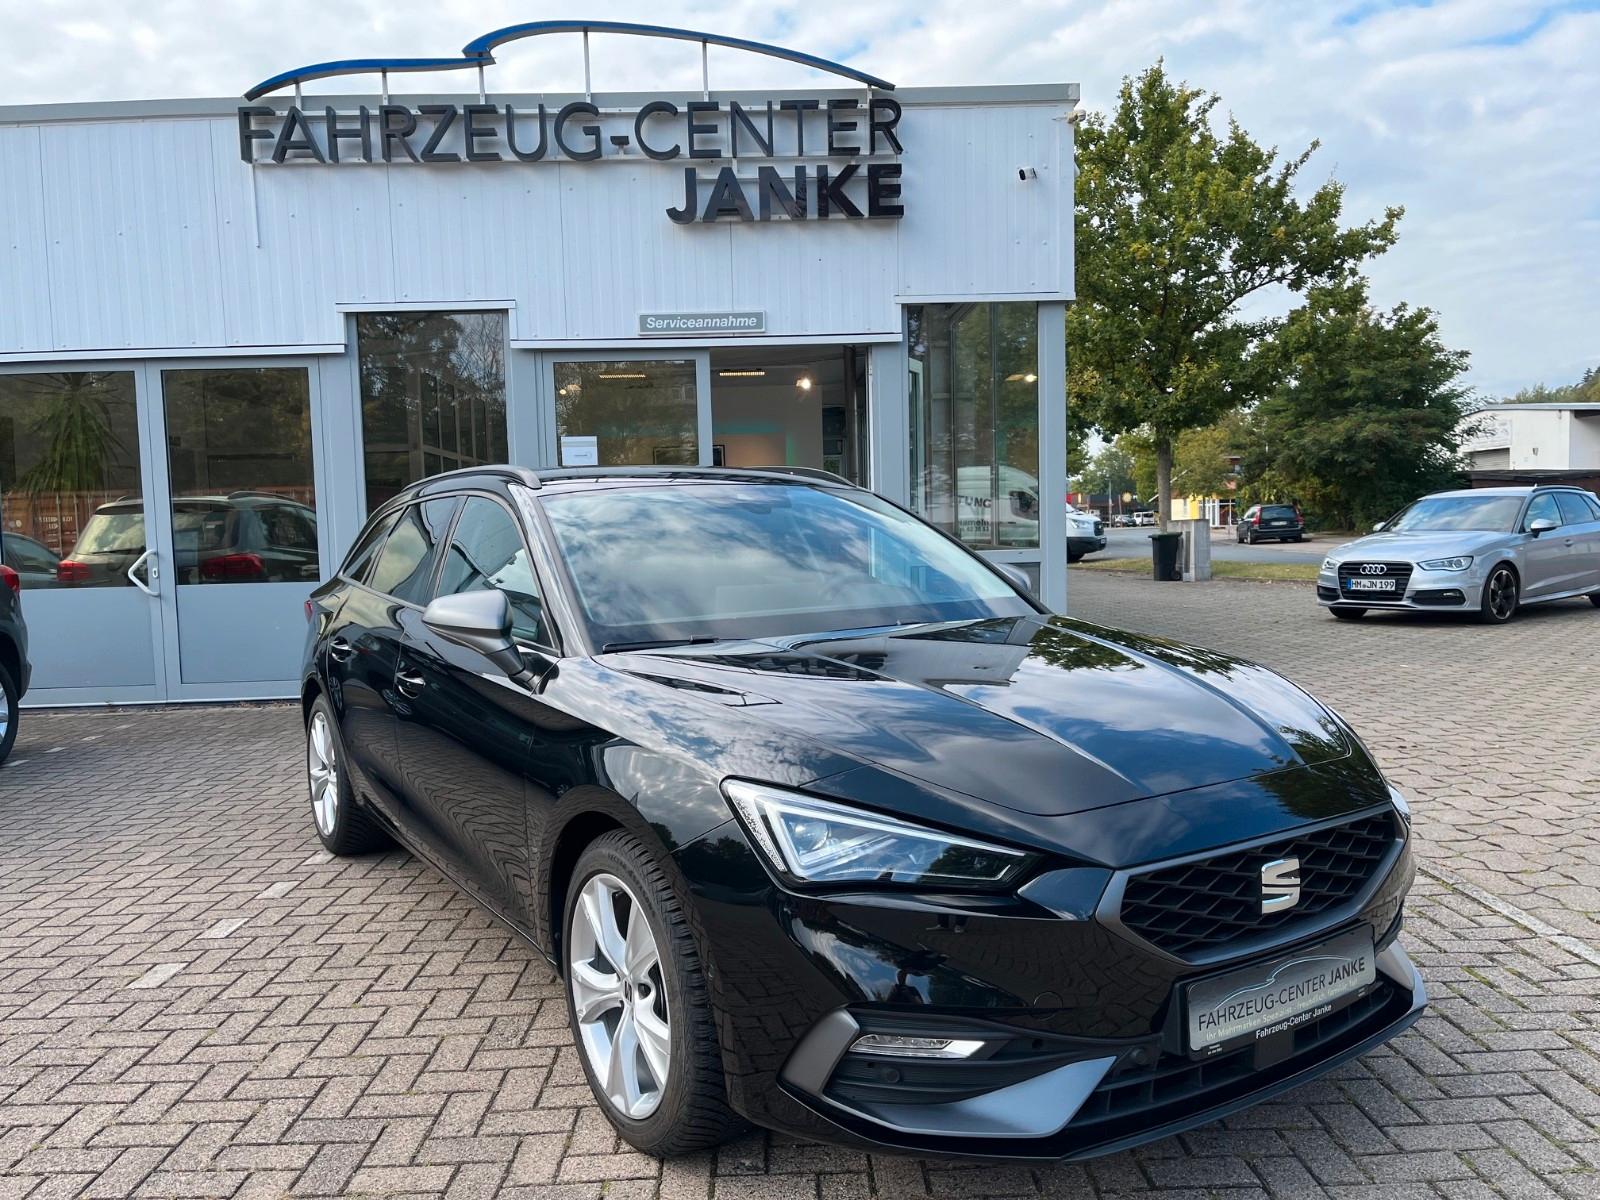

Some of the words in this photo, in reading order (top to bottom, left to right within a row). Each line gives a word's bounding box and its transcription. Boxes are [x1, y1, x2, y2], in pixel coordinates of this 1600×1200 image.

[237, 98, 904, 164] FAHRZEUG-CENTER
[665, 163, 904, 224] JANKE
[646, 315, 757, 329] Serviceannahme
[1367, 580, 1378, 589] JN
[1379, 580, 1395, 589] 199
[1198, 974, 1326, 1031] FAHRZEUG-CENTER
[1328, 956, 1365, 985] JANKE
[1255, 1012, 1312, 1040] Fahrzeug-Center
[1312, 1004, 1332, 1017] Janke
